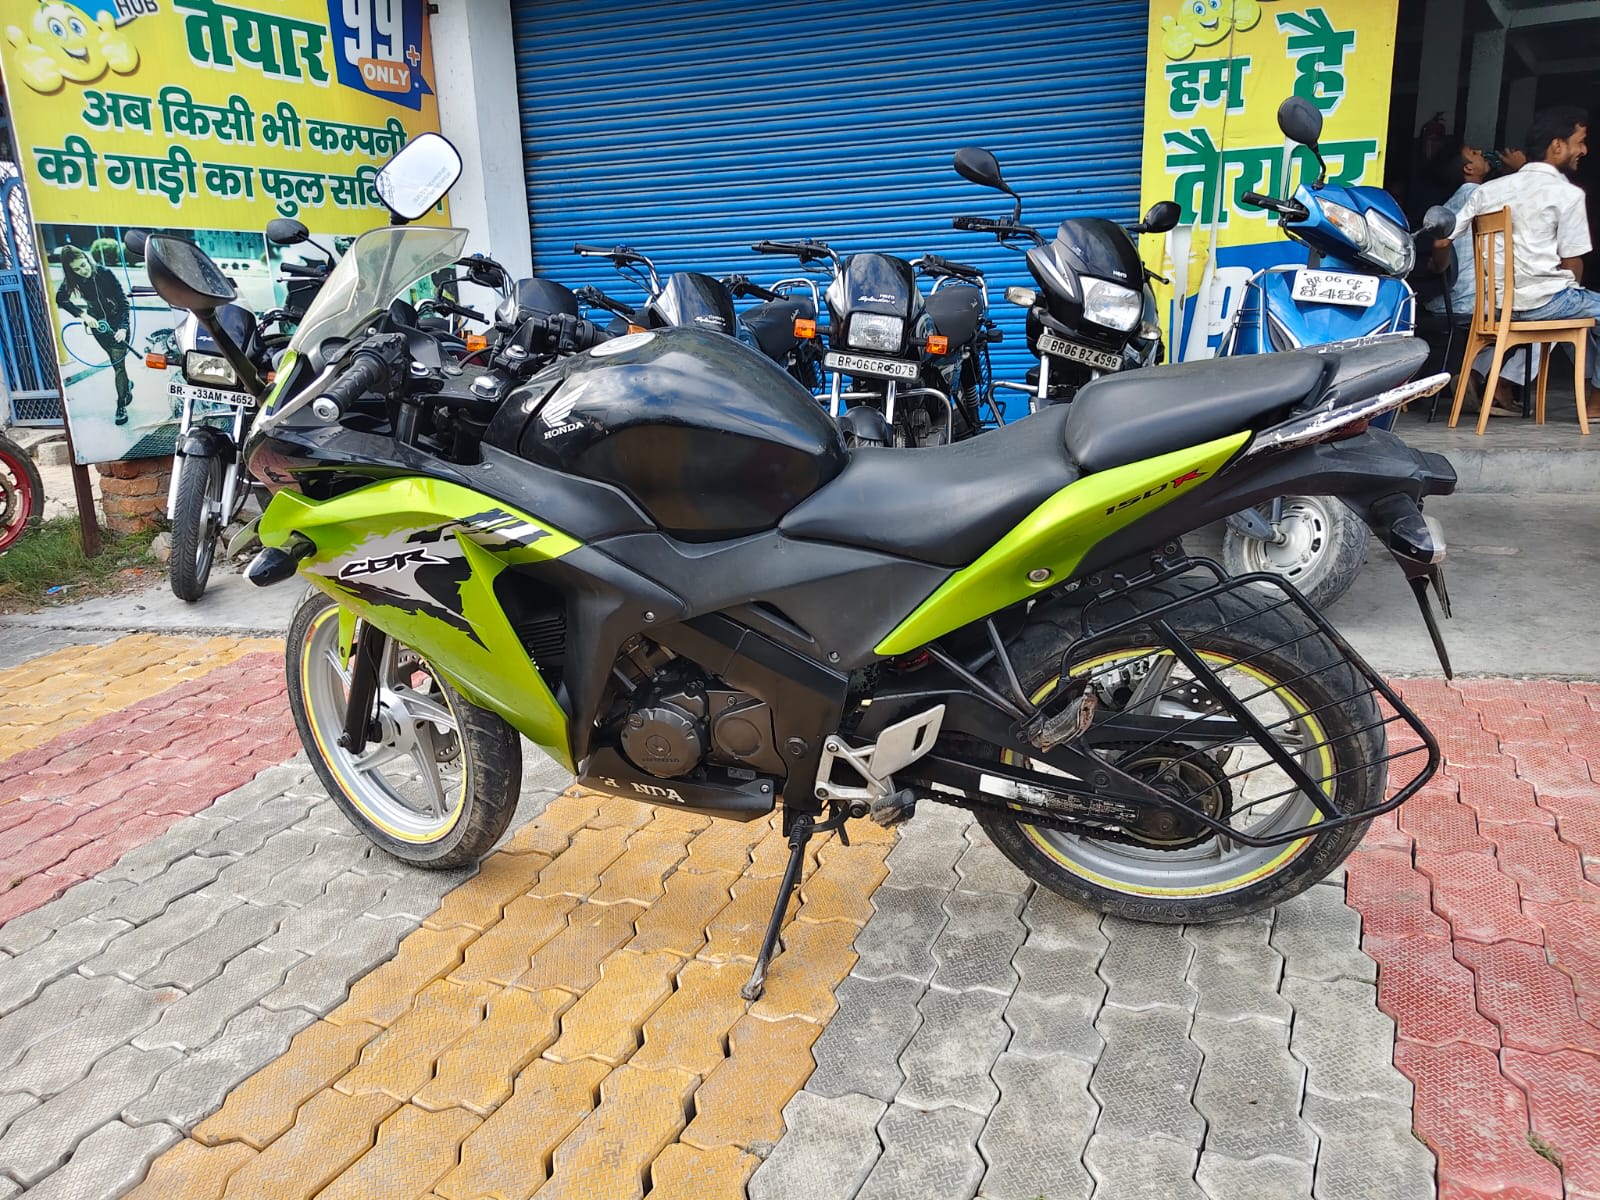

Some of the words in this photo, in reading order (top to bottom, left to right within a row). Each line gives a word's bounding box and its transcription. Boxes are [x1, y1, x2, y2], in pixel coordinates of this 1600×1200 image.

[1277, 8, 1355, 110] है
[363, 64, 410, 86] ONLY
[1167, 58, 1251, 113] हम
[83, 91, 151, 130] अब
[158, 86, 255, 142] किसी
[262, 102, 301, 147] भी
[307, 118, 407, 156] कम्पनी
[33, 135, 97, 186] की
[105, 145, 197, 204] गाड़ी
[203, 163, 254, 197] का
[259, 168, 326, 218] फुल
[1299, 285, 1373, 303] 8486
[1305, 275, 1321, 286] BR
[1325, 275, 1342, 283] 06
[230, 394, 253, 406] 4652
[543, 421, 585, 440] HONDA
[339, 547, 450, 579] CBR
